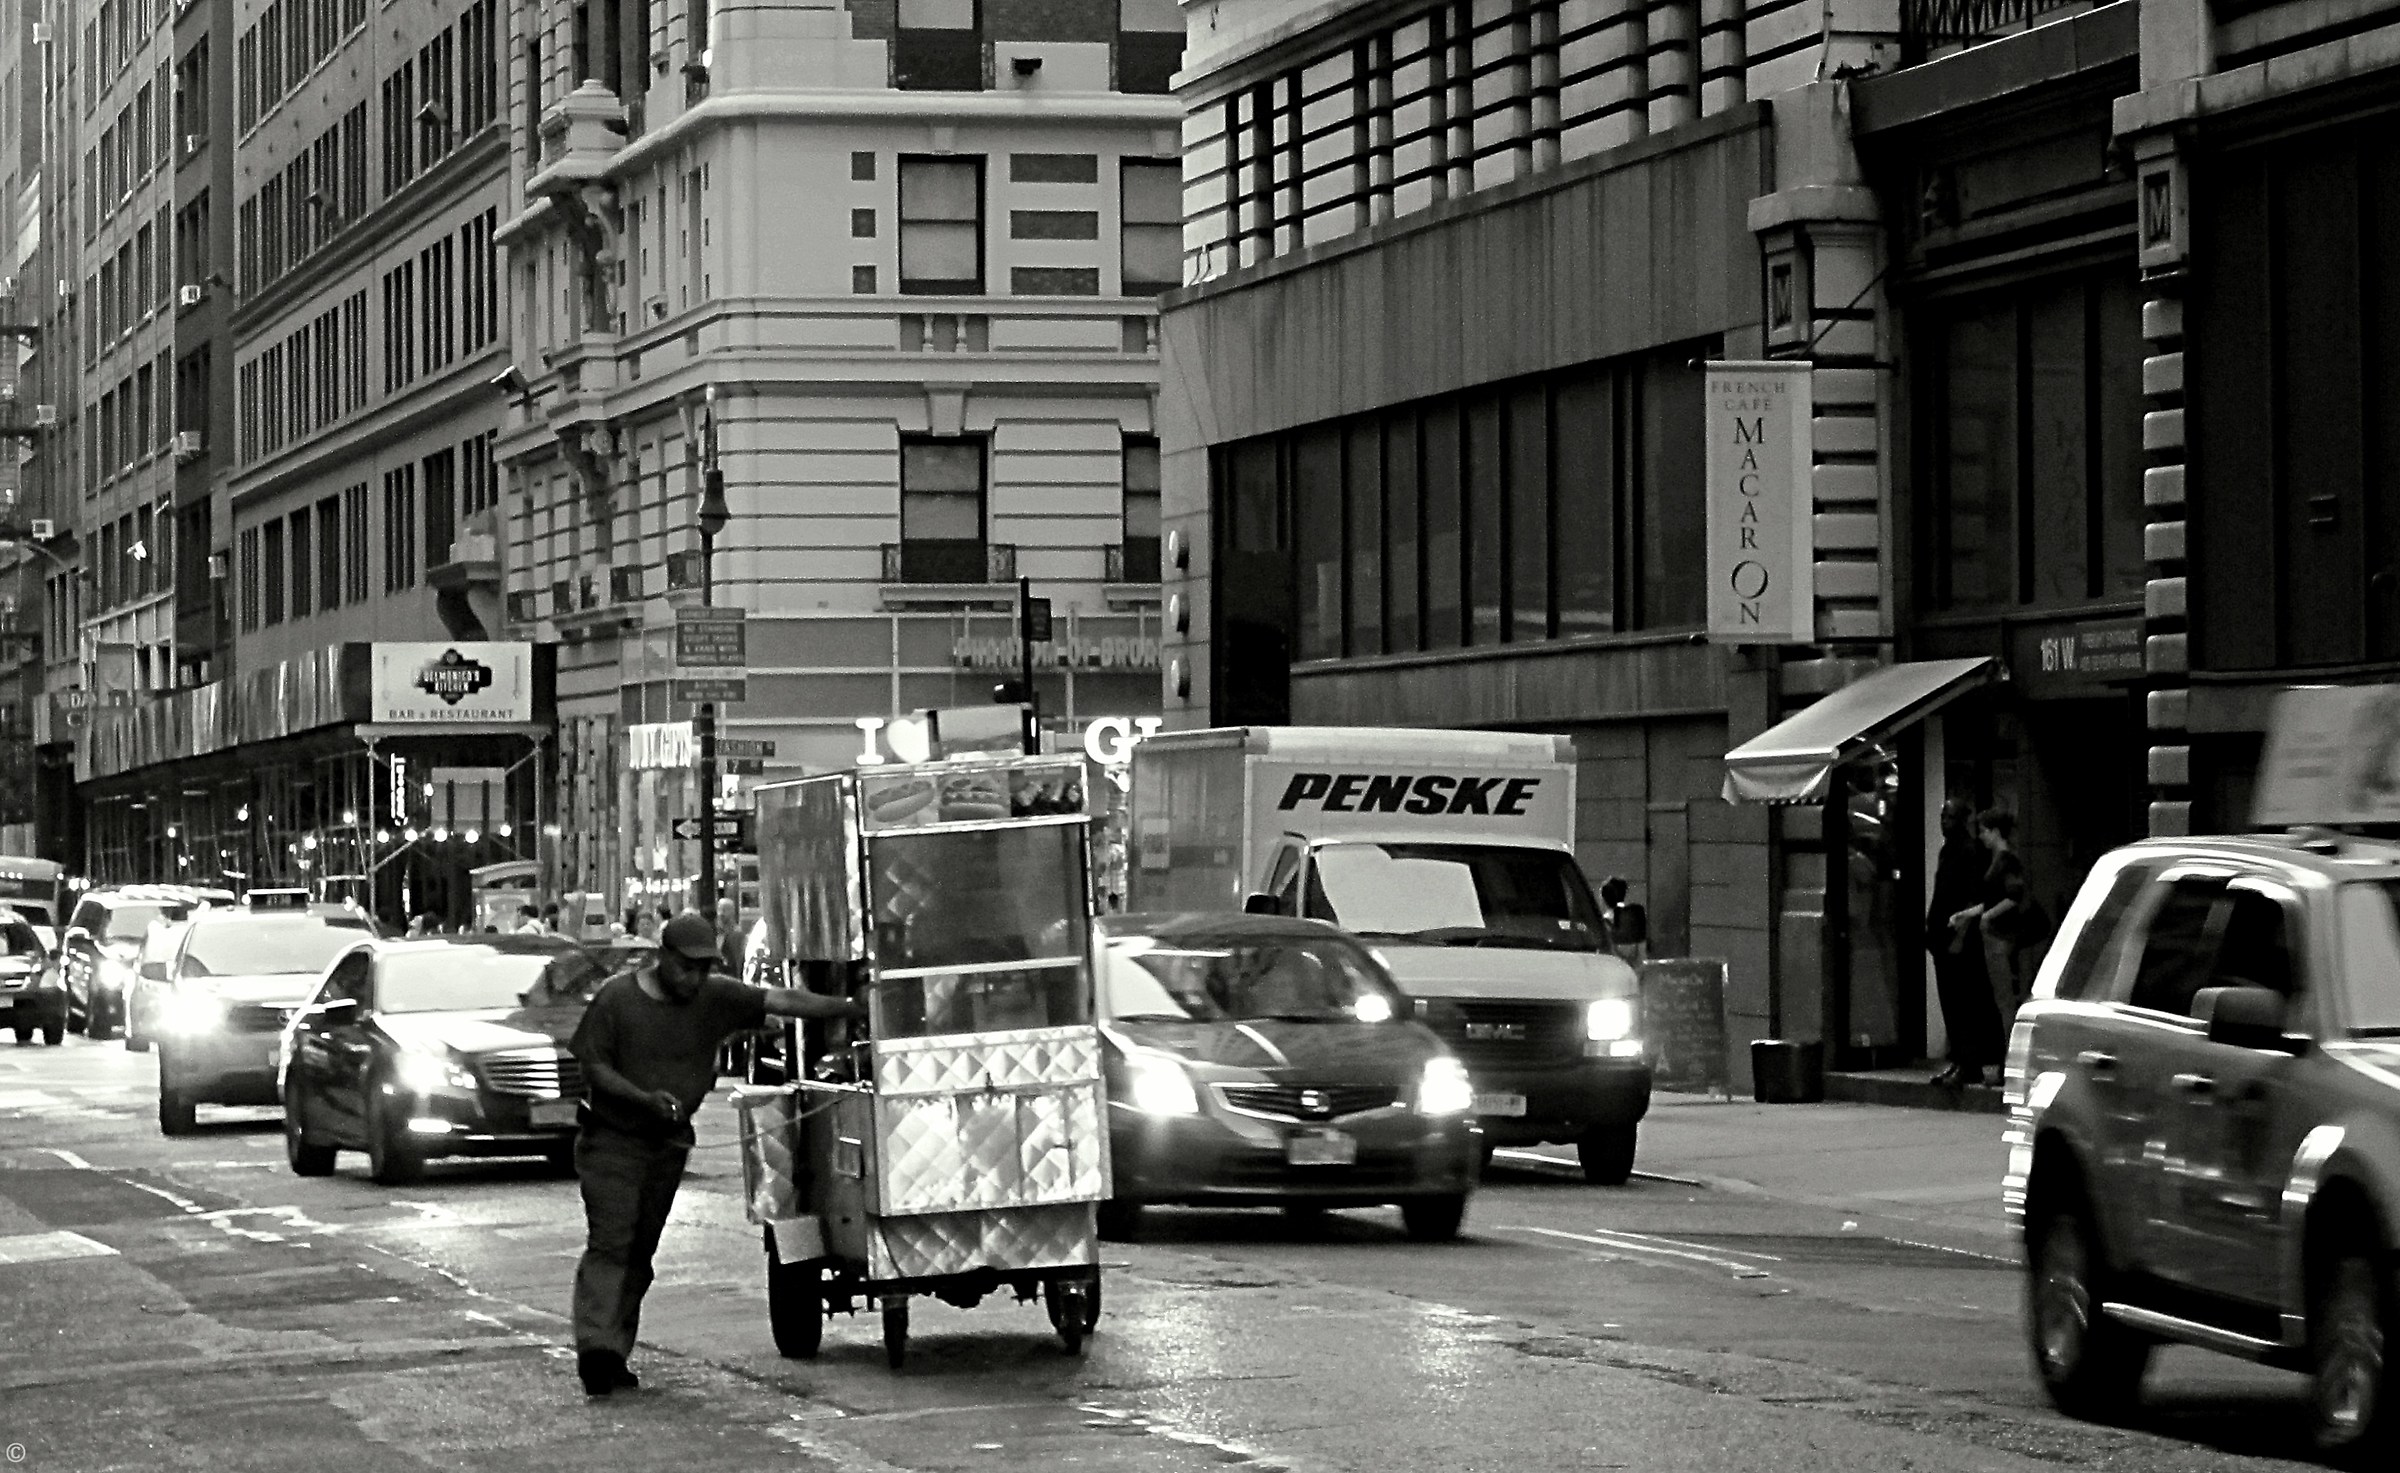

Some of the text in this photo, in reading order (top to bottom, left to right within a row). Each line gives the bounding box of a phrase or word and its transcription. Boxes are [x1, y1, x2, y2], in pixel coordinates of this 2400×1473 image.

[1711, 381, 1785, 394] FRENCH
[1731, 416, 1769, 625] MACARON
[2061, 636, 2075, 670] W
[389, 709, 414, 719] BAR
[430, 709, 514, 719] RESTAURANT
[855, 717, 885, 765] I
[1277, 773, 1541, 816] PENSKE
